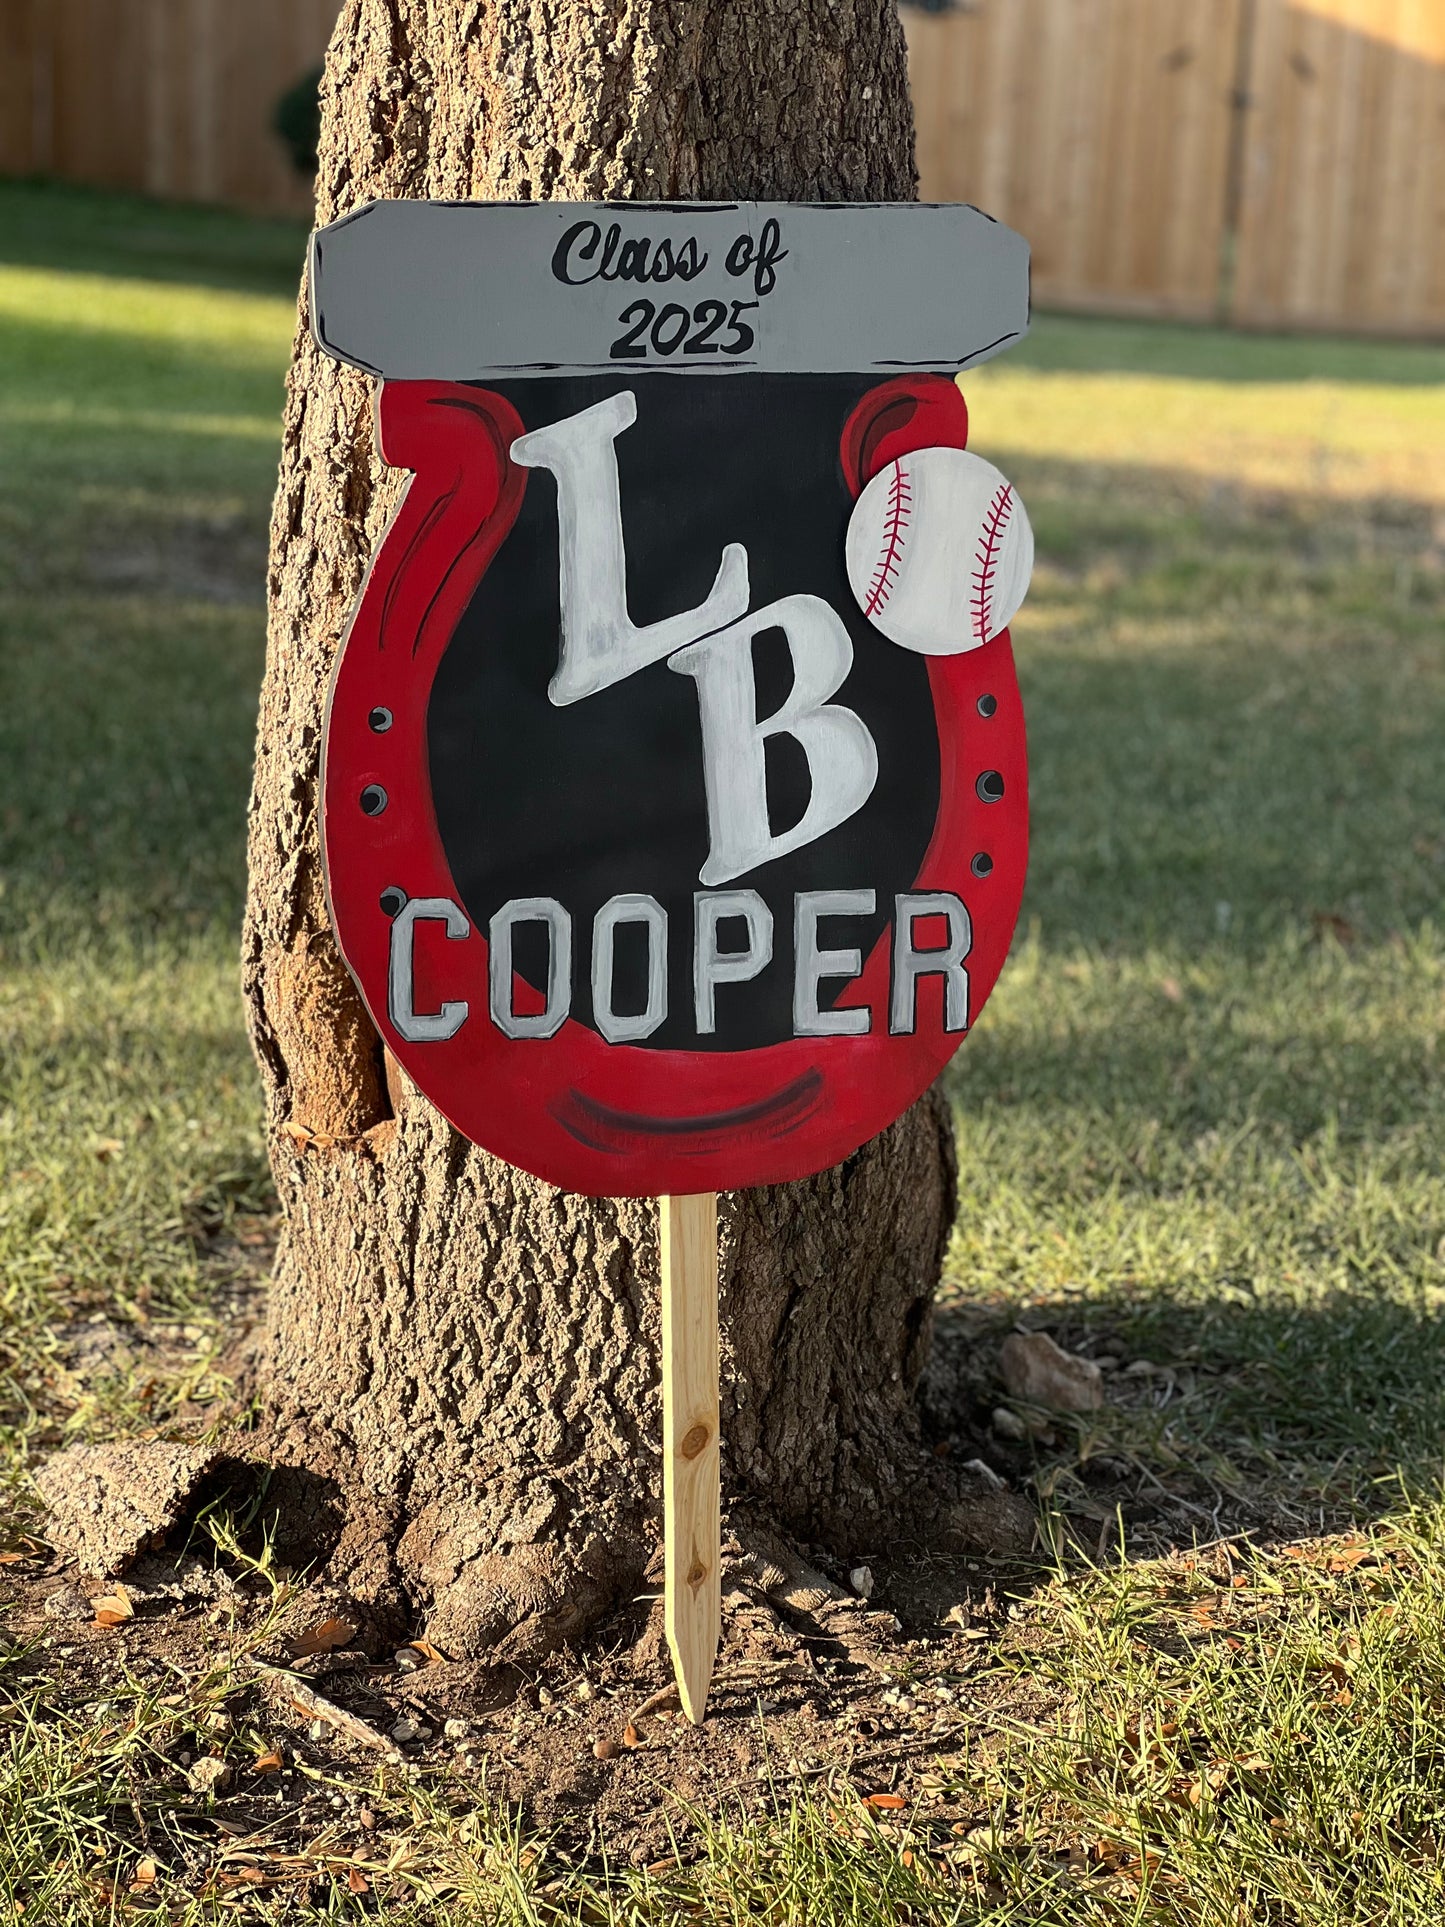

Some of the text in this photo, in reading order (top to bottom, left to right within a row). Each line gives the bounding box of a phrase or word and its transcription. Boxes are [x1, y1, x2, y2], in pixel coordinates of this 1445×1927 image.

[551, 218, 789, 296] Class of
[609, 298, 760, 359] 2025
[388, 888, 972, 1043] COOPER
